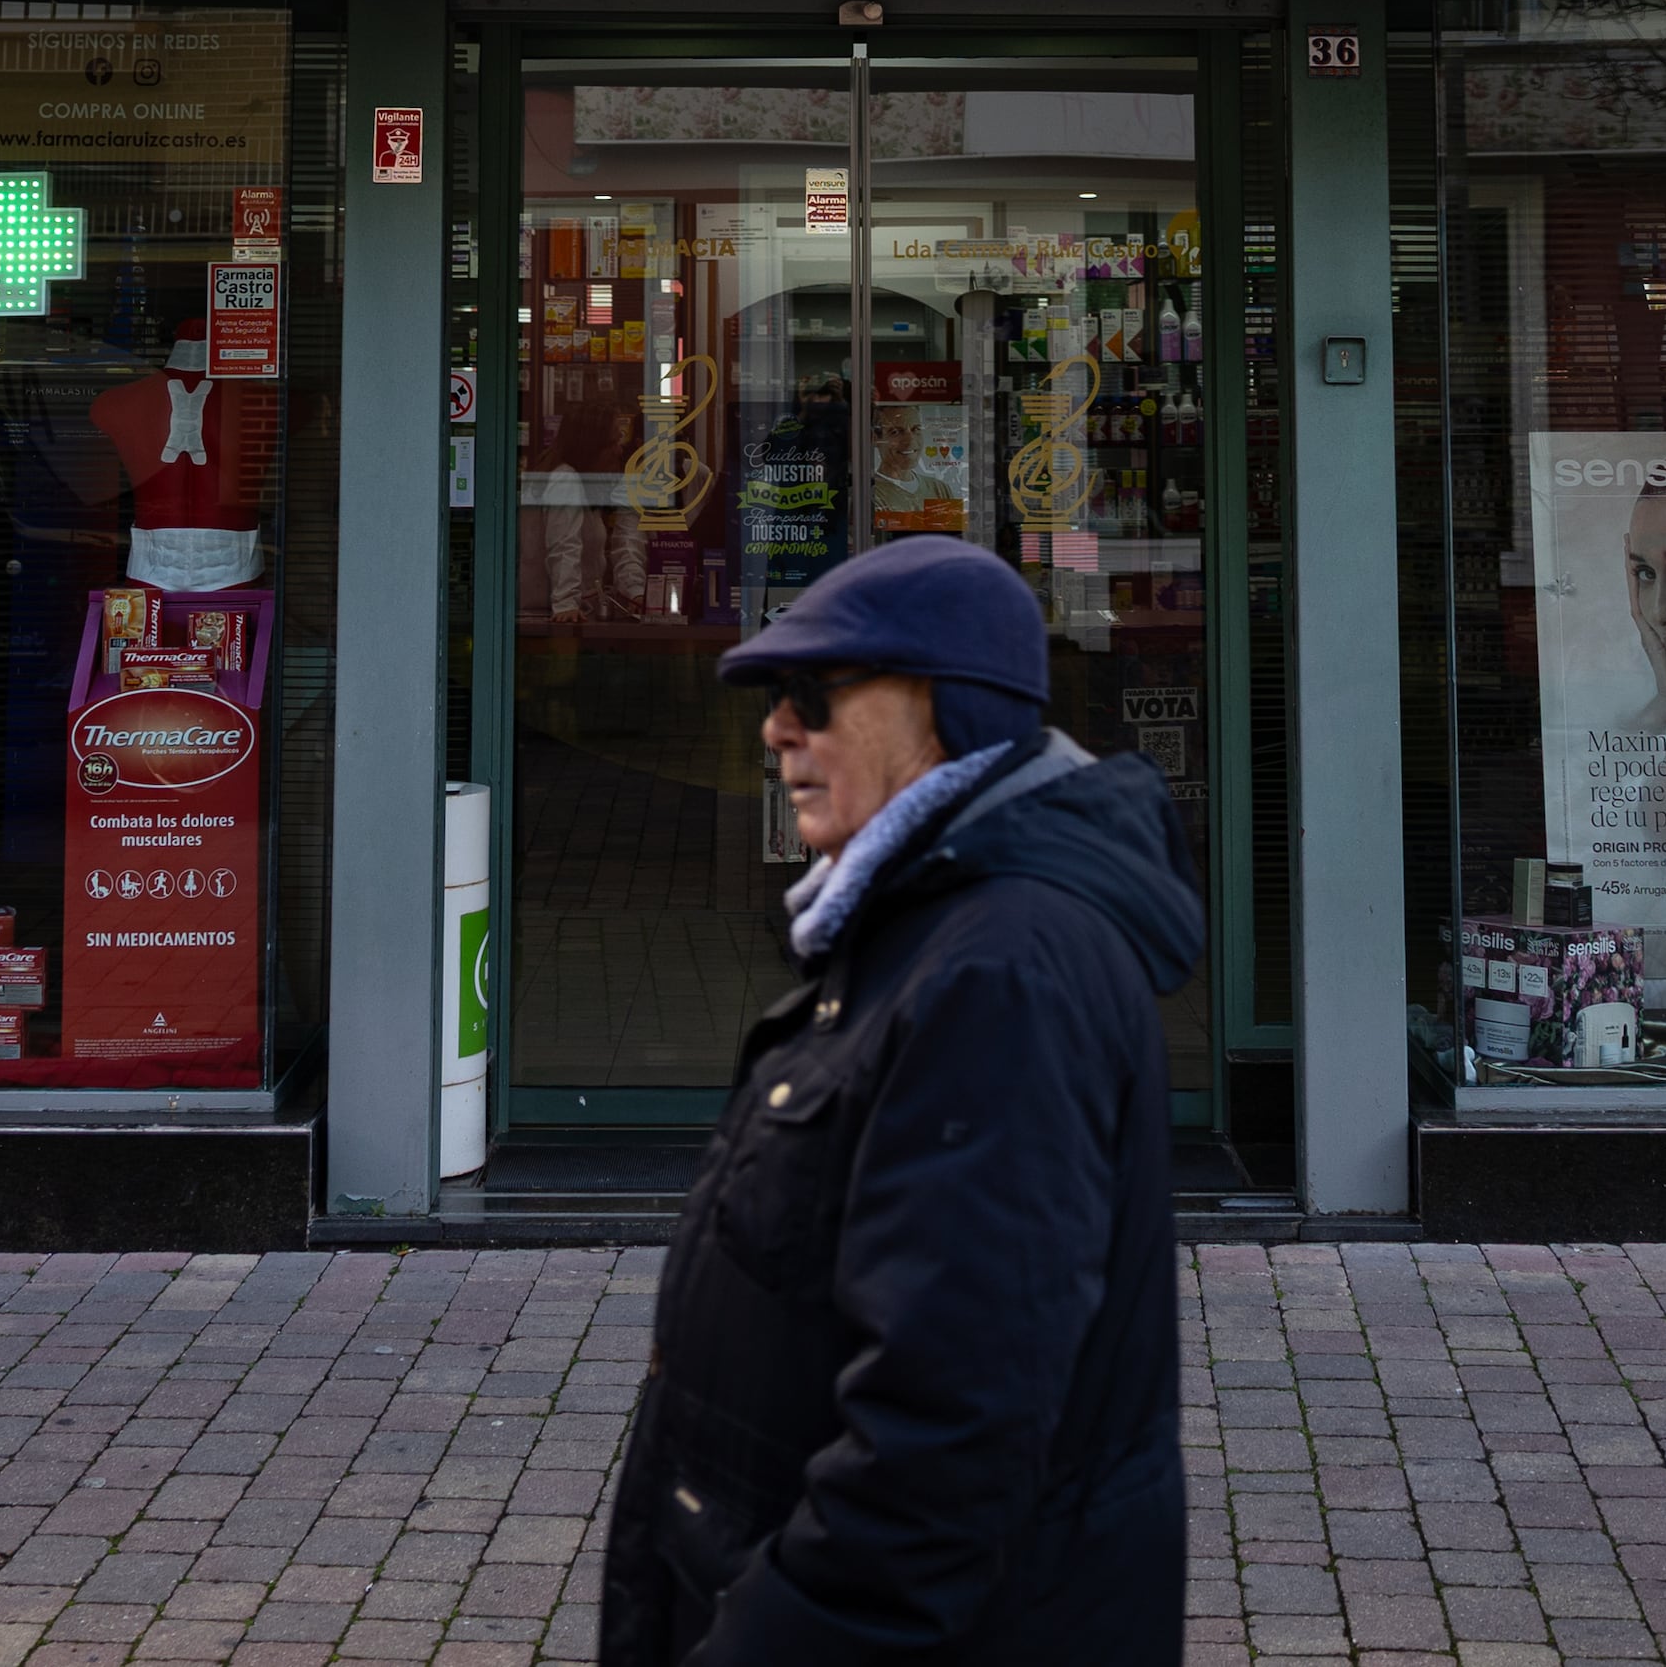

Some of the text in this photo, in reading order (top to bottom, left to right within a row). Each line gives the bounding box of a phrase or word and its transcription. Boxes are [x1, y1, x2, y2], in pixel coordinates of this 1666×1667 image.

[27, 30, 220, 51] SÍGUENOS EN REDES
[1312, 37, 1357, 65] 36
[38, 102, 205, 120] COMPRA ONLINE
[378, 112, 420, 123] Vigilante
[399, 156, 417, 165] 24H
[240, 190, 275, 199] Alarma
[808, 195, 846, 204] Alarma
[602, 237, 736, 257] FARMACIA
[893, 239, 1159, 260] Lda. Carmen Ruiz Castro
[216, 268, 274, 280] Farmacia
[216, 280, 273, 294] Castro
[891, 374, 947, 391] aposán
[743, 441, 827, 468] Cuidarte
[764, 464, 825, 483] NUESTRA
[750, 488, 823, 505] VOCACIÓN
[751, 524, 808, 542] NUESTRO
[744, 540, 829, 561] compromiso
[124, 652, 208, 663] ThermaCare
[1125, 697, 1195, 719] VOTA
[83, 725, 242, 747] ThermaCare
[198, 747, 239, 755] Terapéuticos
[1588, 755, 1607, 777] el
[90, 813, 235, 829] Combata los dolores
[1591, 805, 1619, 828] de
[1625, 808, 1647, 828] tu
[121, 832, 203, 847] musculares
[1592, 842, 1640, 854] ORIGIN
[1592, 859, 1612, 867] Con
[1613, 859, 1620, 867] 5
[1620, 859, 1659, 867] factores
[1594, 881, 1631, 895] -45%
[86, 931, 236, 947] SIN MEDICAMENTOS
[1567, 937, 1617, 956] sensilis
[1463, 963, 1544, 984] -43% -13% +22%
